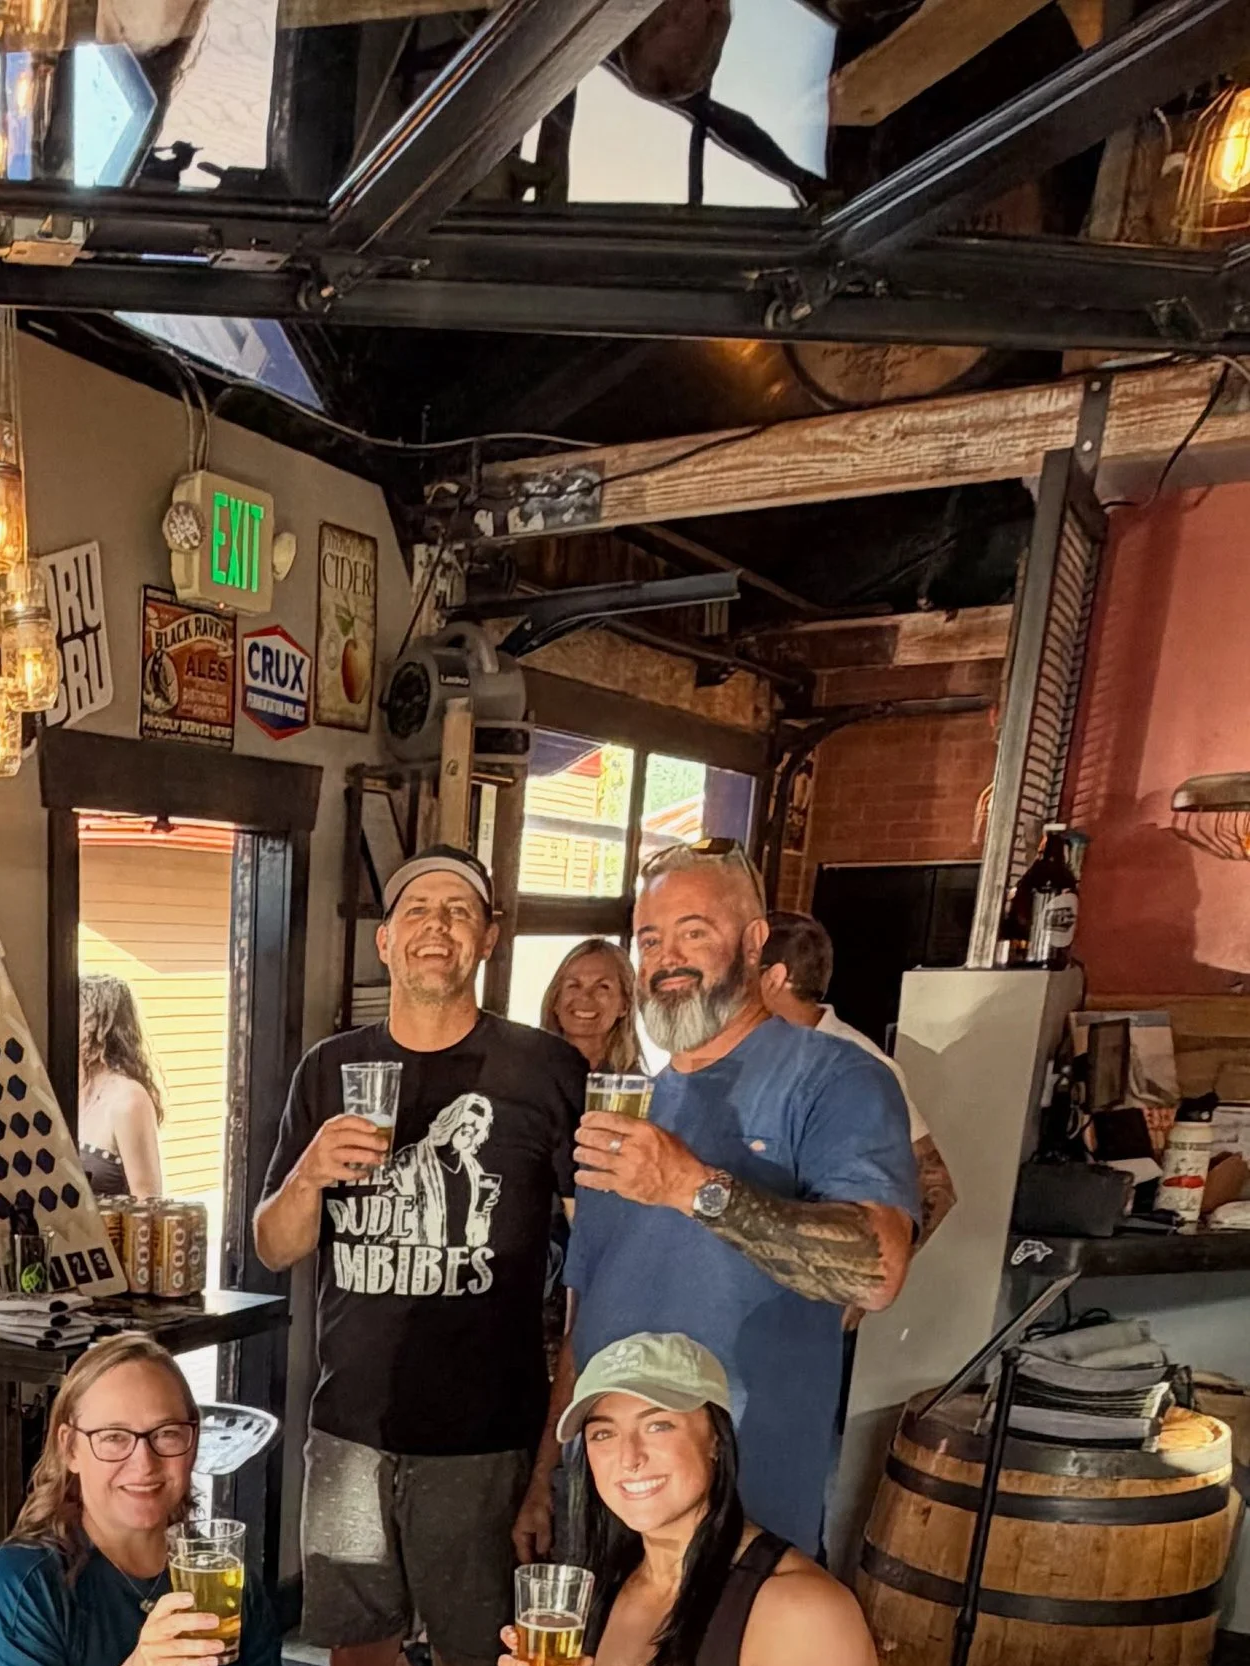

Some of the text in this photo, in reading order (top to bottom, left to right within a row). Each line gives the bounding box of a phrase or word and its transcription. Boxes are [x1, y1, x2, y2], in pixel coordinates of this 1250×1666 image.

[212, 491, 265, 593] EXIT
[321, 551, 372, 597] CIDER
[155, 616, 227, 651] BLACK RAVEN
[185, 655, 228, 682] ALES
[247, 641, 306, 694] CRUX
[326, 1194, 415, 1237] DUDE
[72, 1255, 86, 1276] 2
[93, 1252, 108, 1271] 3
[332, 1240, 495, 1296] IMBIBES
